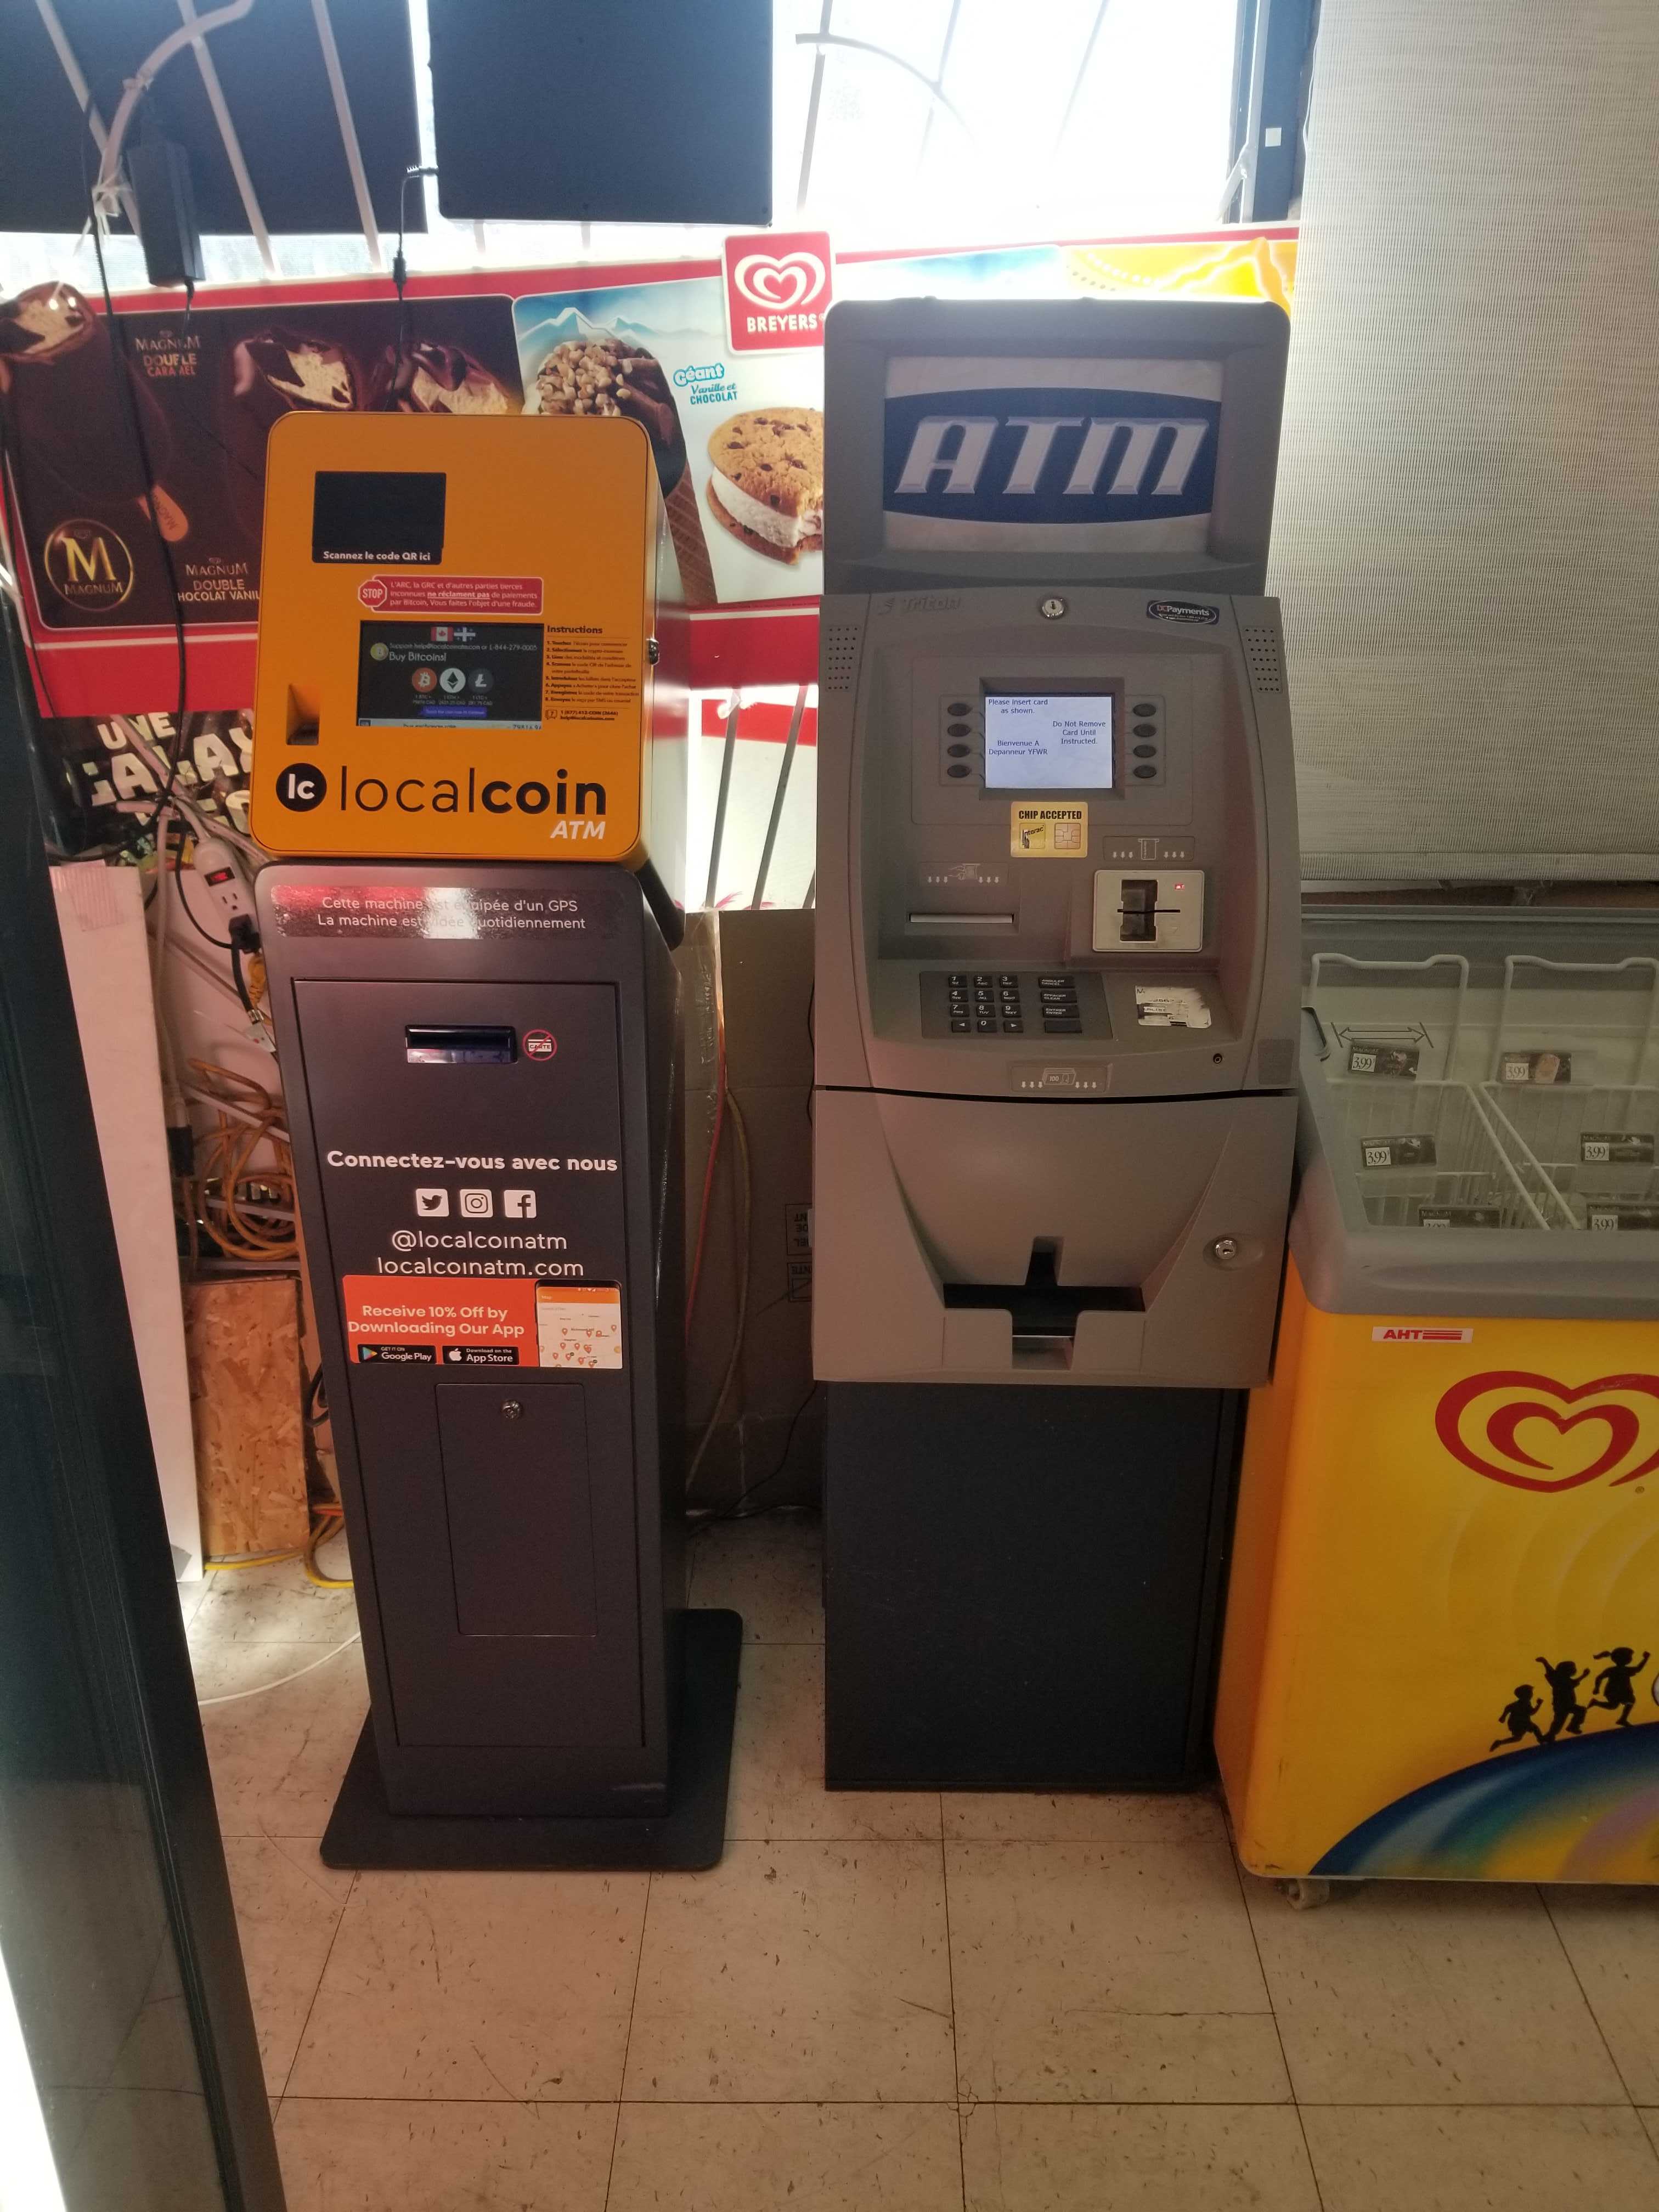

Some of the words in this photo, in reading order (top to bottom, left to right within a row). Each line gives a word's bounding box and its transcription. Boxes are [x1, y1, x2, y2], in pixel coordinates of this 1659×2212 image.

[747, 313, 817, 334] BREYERS
[674, 363, 724, 387] Géant
[691, 385, 725, 394] Vanille
[690, 391, 737, 405] CHOCOLAT
[894, 415, 1210, 495] ATM
[58, 535, 116, 582] M
[323, 551, 363, 560] Scannez
[365, 551, 374, 560] le
[402, 552, 417, 560] QR
[419, 552, 431, 561] ici
[185, 563, 248, 575] MAGNUM
[63, 582, 123, 595] MAGNUM
[193, 579, 245, 591] DOUBLE
[363, 589, 383, 599] STOP
[547, 625, 602, 634] Instructions
[389, 652, 405, 662] Buy
[341, 766, 606, 816] localcoin
[1019, 811, 1038, 820] CHIP
[1040, 811, 1082, 820] ACCEPTED
[550, 820, 605, 840] ATM
[322, 897, 360, 909] Cette
[365, 898, 424, 910] machine
[514, 900, 544, 911] d'un
[549, 900, 578, 912] GPS
[317, 915, 335, 926] La
[339, 915, 397, 927] machine
[402, 917, 421, 927] est
[1367, 1150, 1386, 1164] 3.99
[1586, 1146, 1605, 1159] 3.99
[327, 1150, 505, 1170] Connectez-vous
[512, 1155, 560, 1170] avec
[567, 1156, 618, 1171] nous
[392, 1230, 567, 1251] @localcoinatm
[377, 1257, 584, 1276] localcoinatm.com
[362, 1305, 426, 1317] Receive
[428, 1307, 456, 1318] 10%
[460, 1307, 484, 1318] Off
[488, 1307, 507, 1322] by
[348, 1321, 455, 1337] Downloading
[459, 1323, 488, 1334] Our
[492, 1323, 524, 1338] App
[1384, 1329, 1423, 1339] AHT
[381, 1352, 413, 1362] Google
[415, 1353, 432, 1362] Play
[466, 1355, 486, 1364] App
